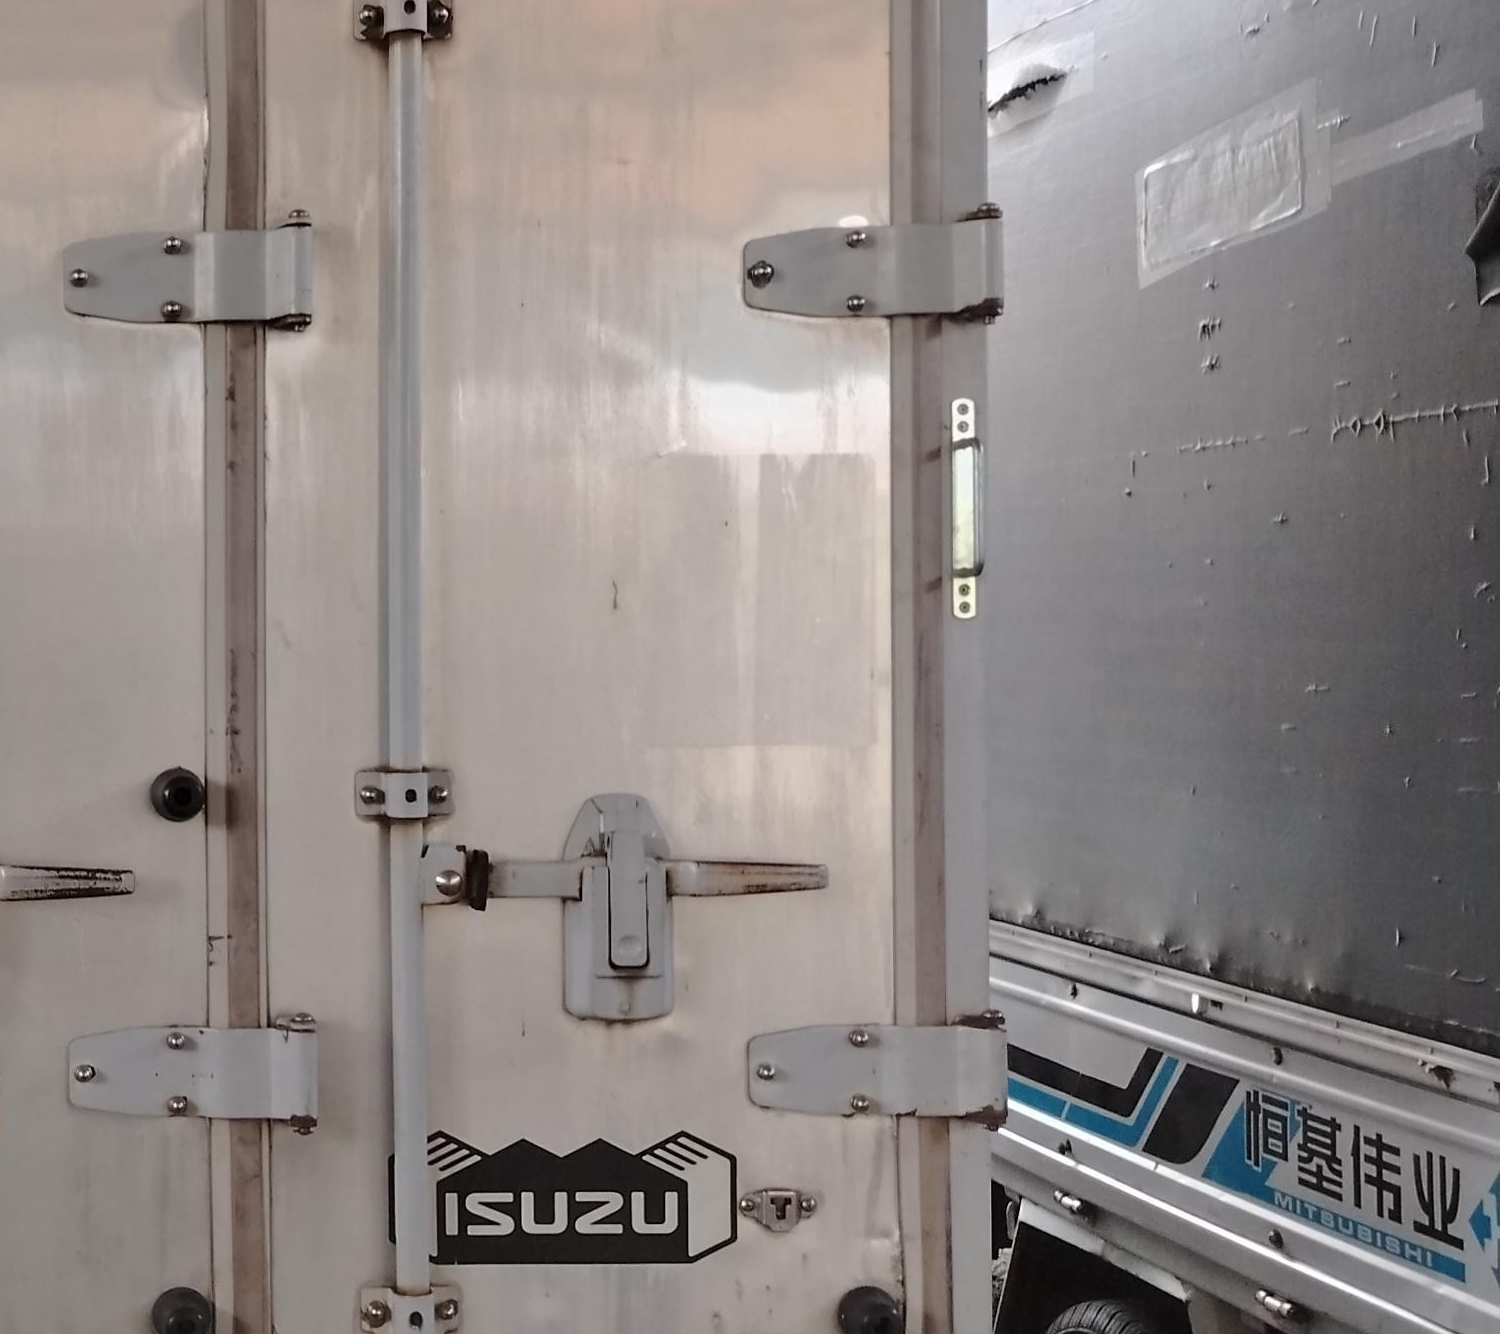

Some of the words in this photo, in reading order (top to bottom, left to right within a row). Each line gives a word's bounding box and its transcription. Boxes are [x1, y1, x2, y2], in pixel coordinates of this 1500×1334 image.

[1244, 1089, 1465, 1252] 恒基伟业
[444, 1191, 679, 1236] ISUZU
[1273, 1190, 1434, 1269] MITSUBISHI
